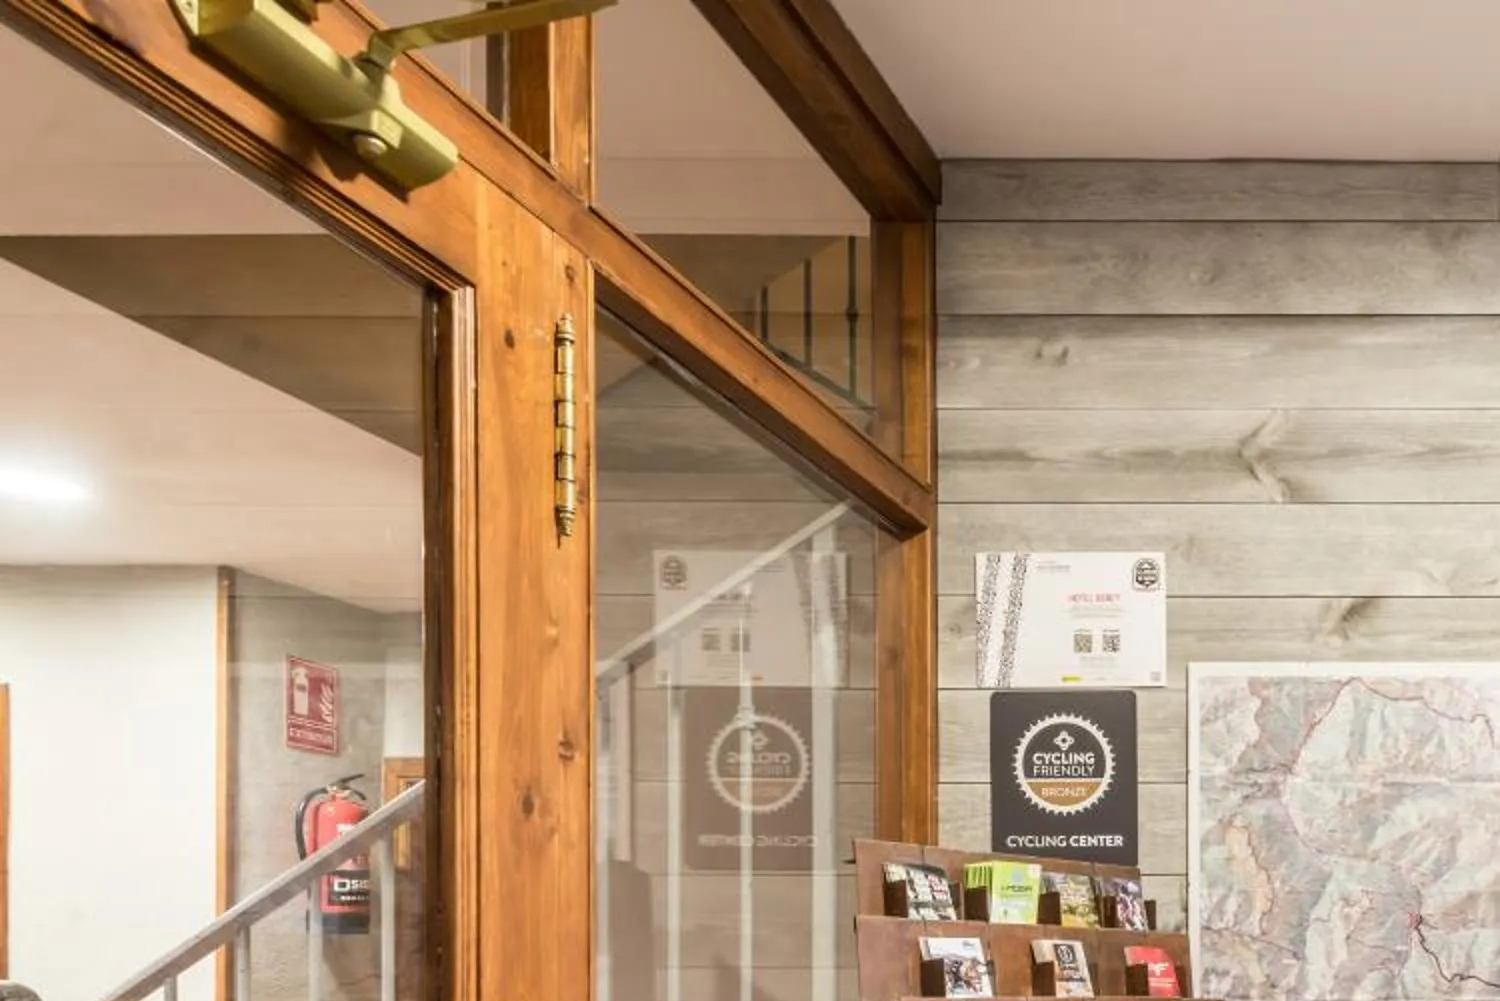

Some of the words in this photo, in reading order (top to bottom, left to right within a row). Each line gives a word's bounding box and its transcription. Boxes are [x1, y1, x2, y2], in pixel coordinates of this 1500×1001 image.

[1032, 752, 1095, 765] CYCLING
[1033, 765, 1095, 777] FRIENDLY
[1041, 787, 1087, 797] BRONZE
[1006, 835, 1067, 847] CYCLING
[1069, 834, 1123, 847] CENTER
